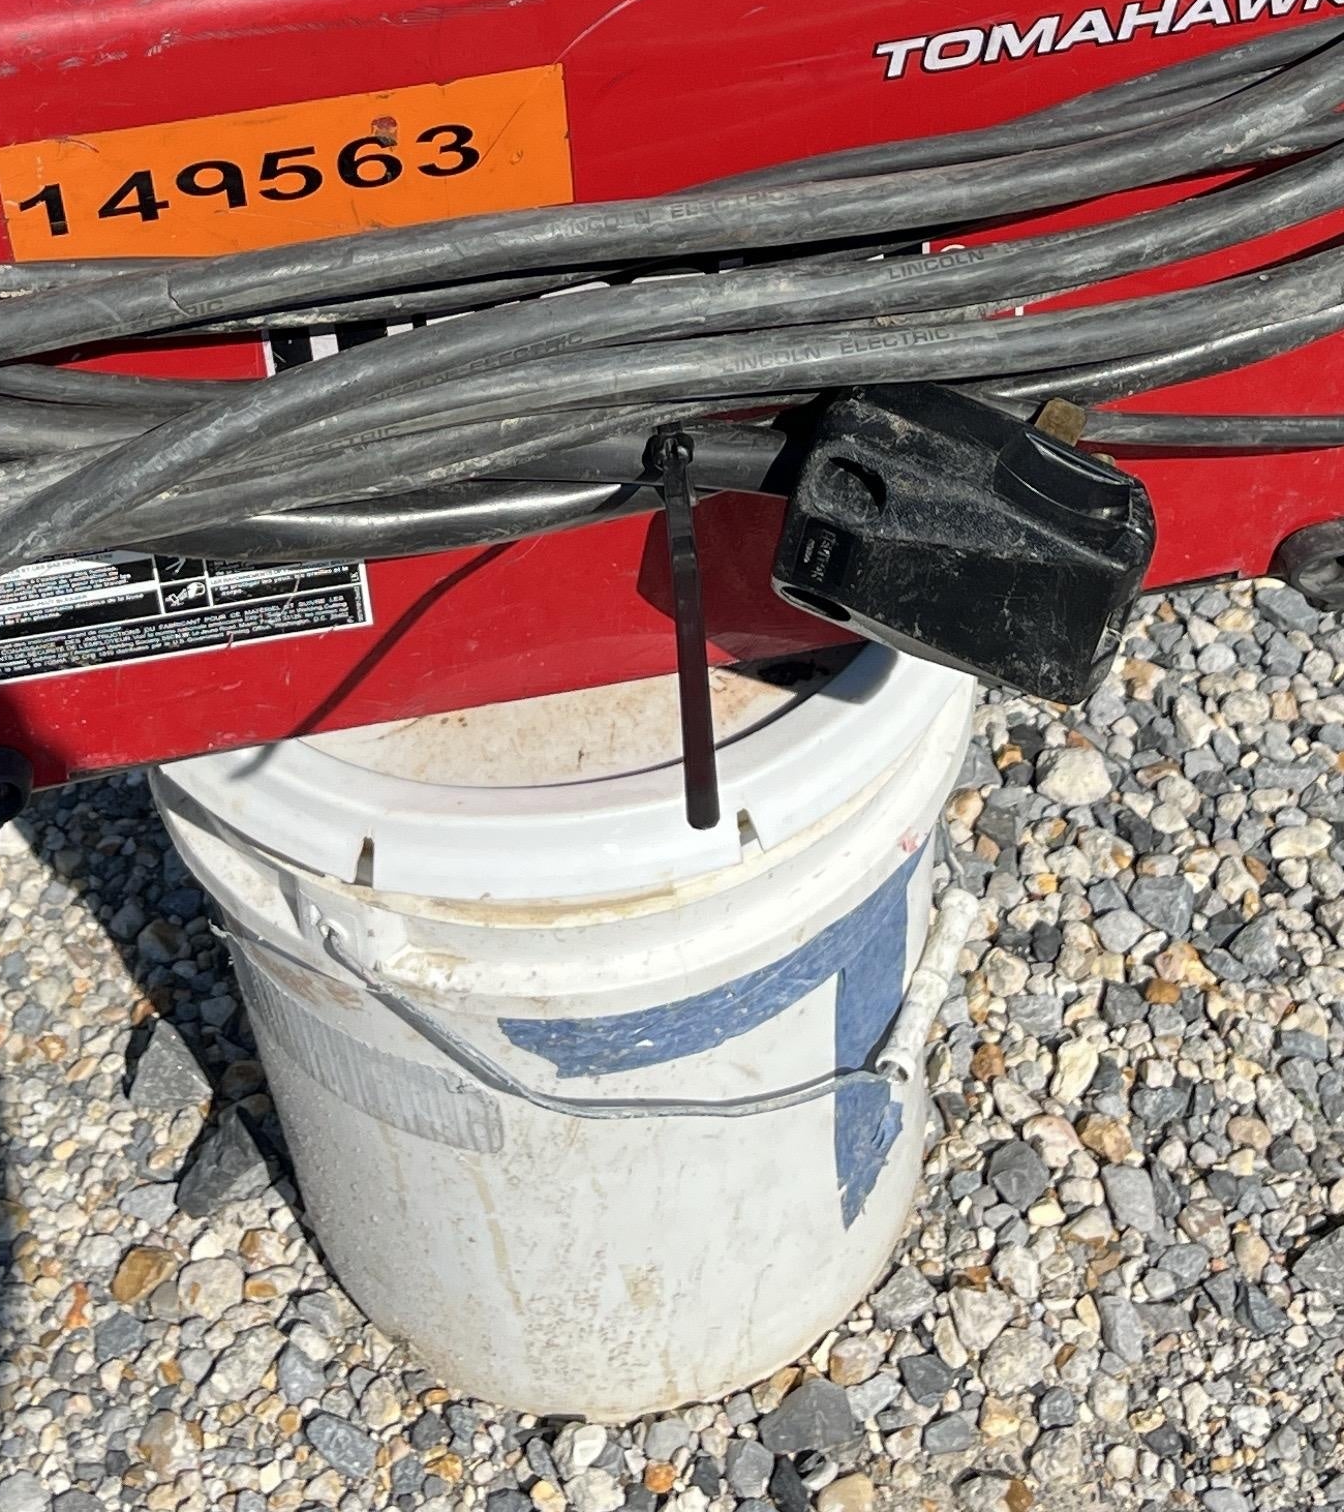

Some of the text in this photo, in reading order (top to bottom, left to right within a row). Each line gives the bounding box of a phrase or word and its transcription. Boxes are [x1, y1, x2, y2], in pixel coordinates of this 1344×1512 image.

[16, 122, 482, 237] 149563
[888, 247, 985, 281] LINCOLN
[722, 328, 951, 375] LINCOLN ELECTRIC
